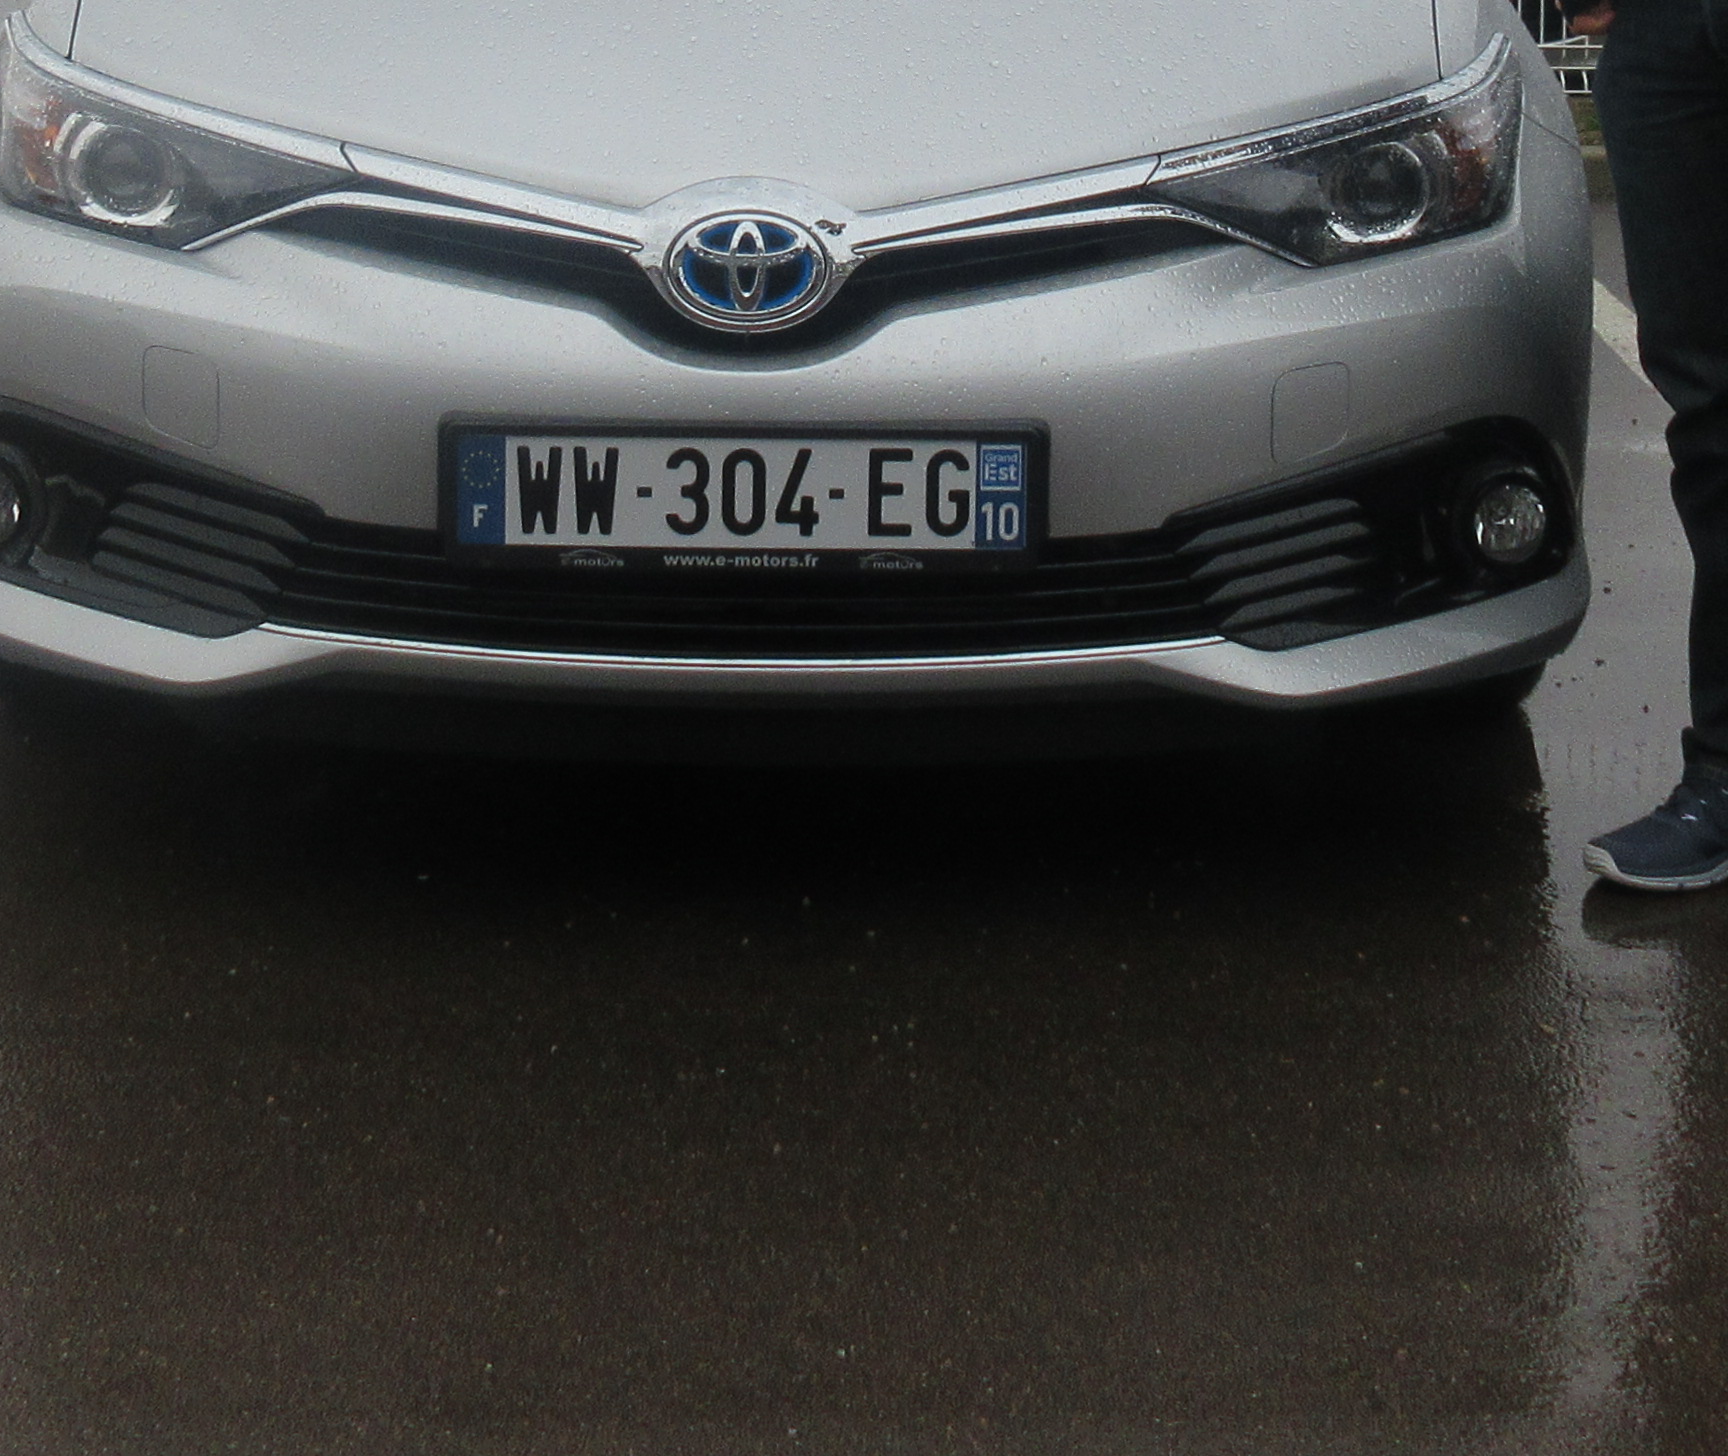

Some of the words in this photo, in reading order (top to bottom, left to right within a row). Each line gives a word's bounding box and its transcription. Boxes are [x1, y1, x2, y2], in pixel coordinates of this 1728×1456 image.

[984, 452, 1019, 464] Grand
[984, 463, 1019, 482] Est
[517, 445, 971, 537] WW-304-EG
[473, 504, 488, 528] F
[980, 501, 1020, 542] 10
[663, 554, 820, 568] www.e-motors.fr
